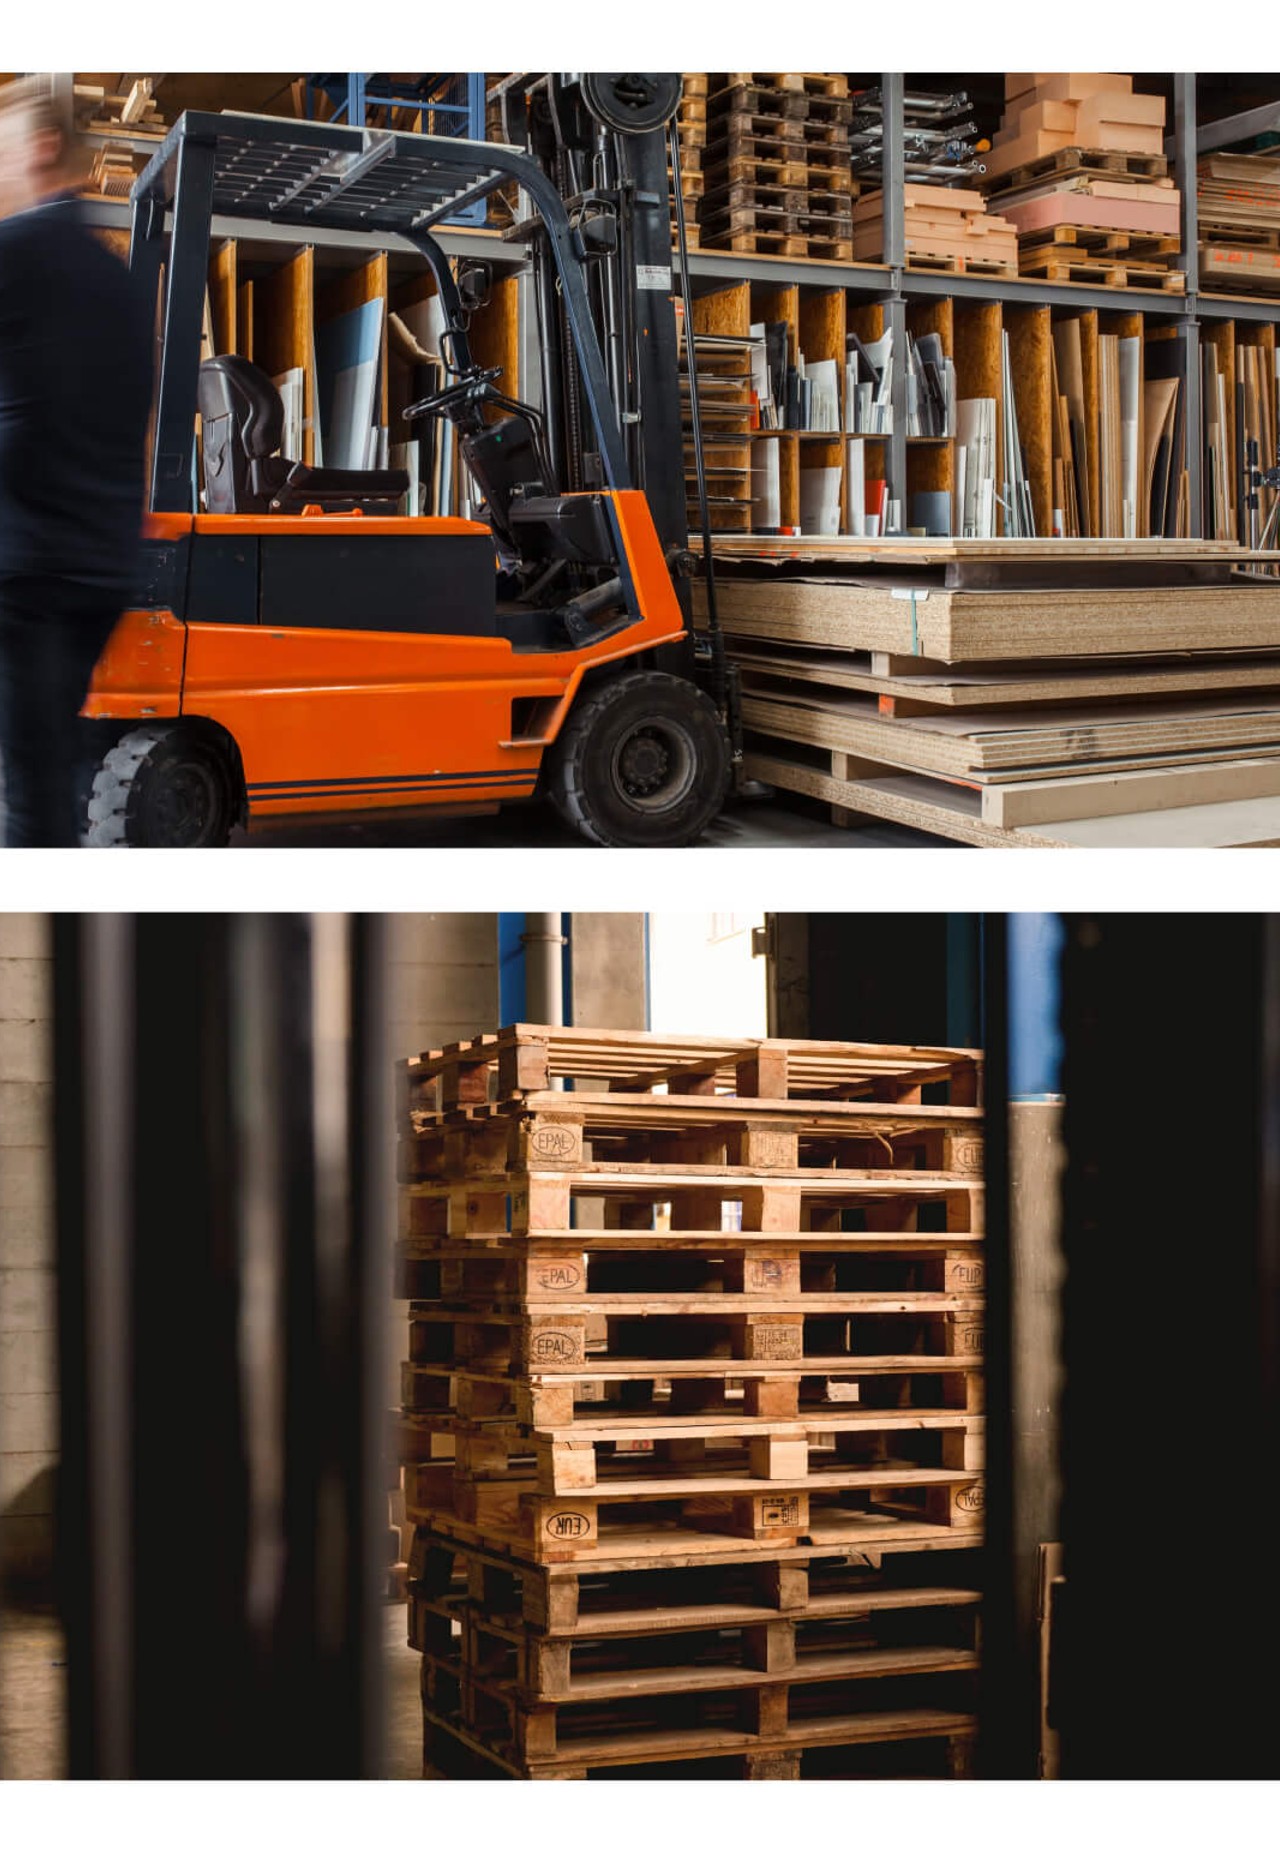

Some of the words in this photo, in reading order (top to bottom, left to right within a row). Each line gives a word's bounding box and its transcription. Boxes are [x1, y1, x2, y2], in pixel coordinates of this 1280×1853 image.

[538, 1133, 569, 1150] EPAL
[541, 1267, 573, 1284] EPAL
[538, 1338, 568, 1354] EPAL
[555, 1517, 581, 1535] EUR
